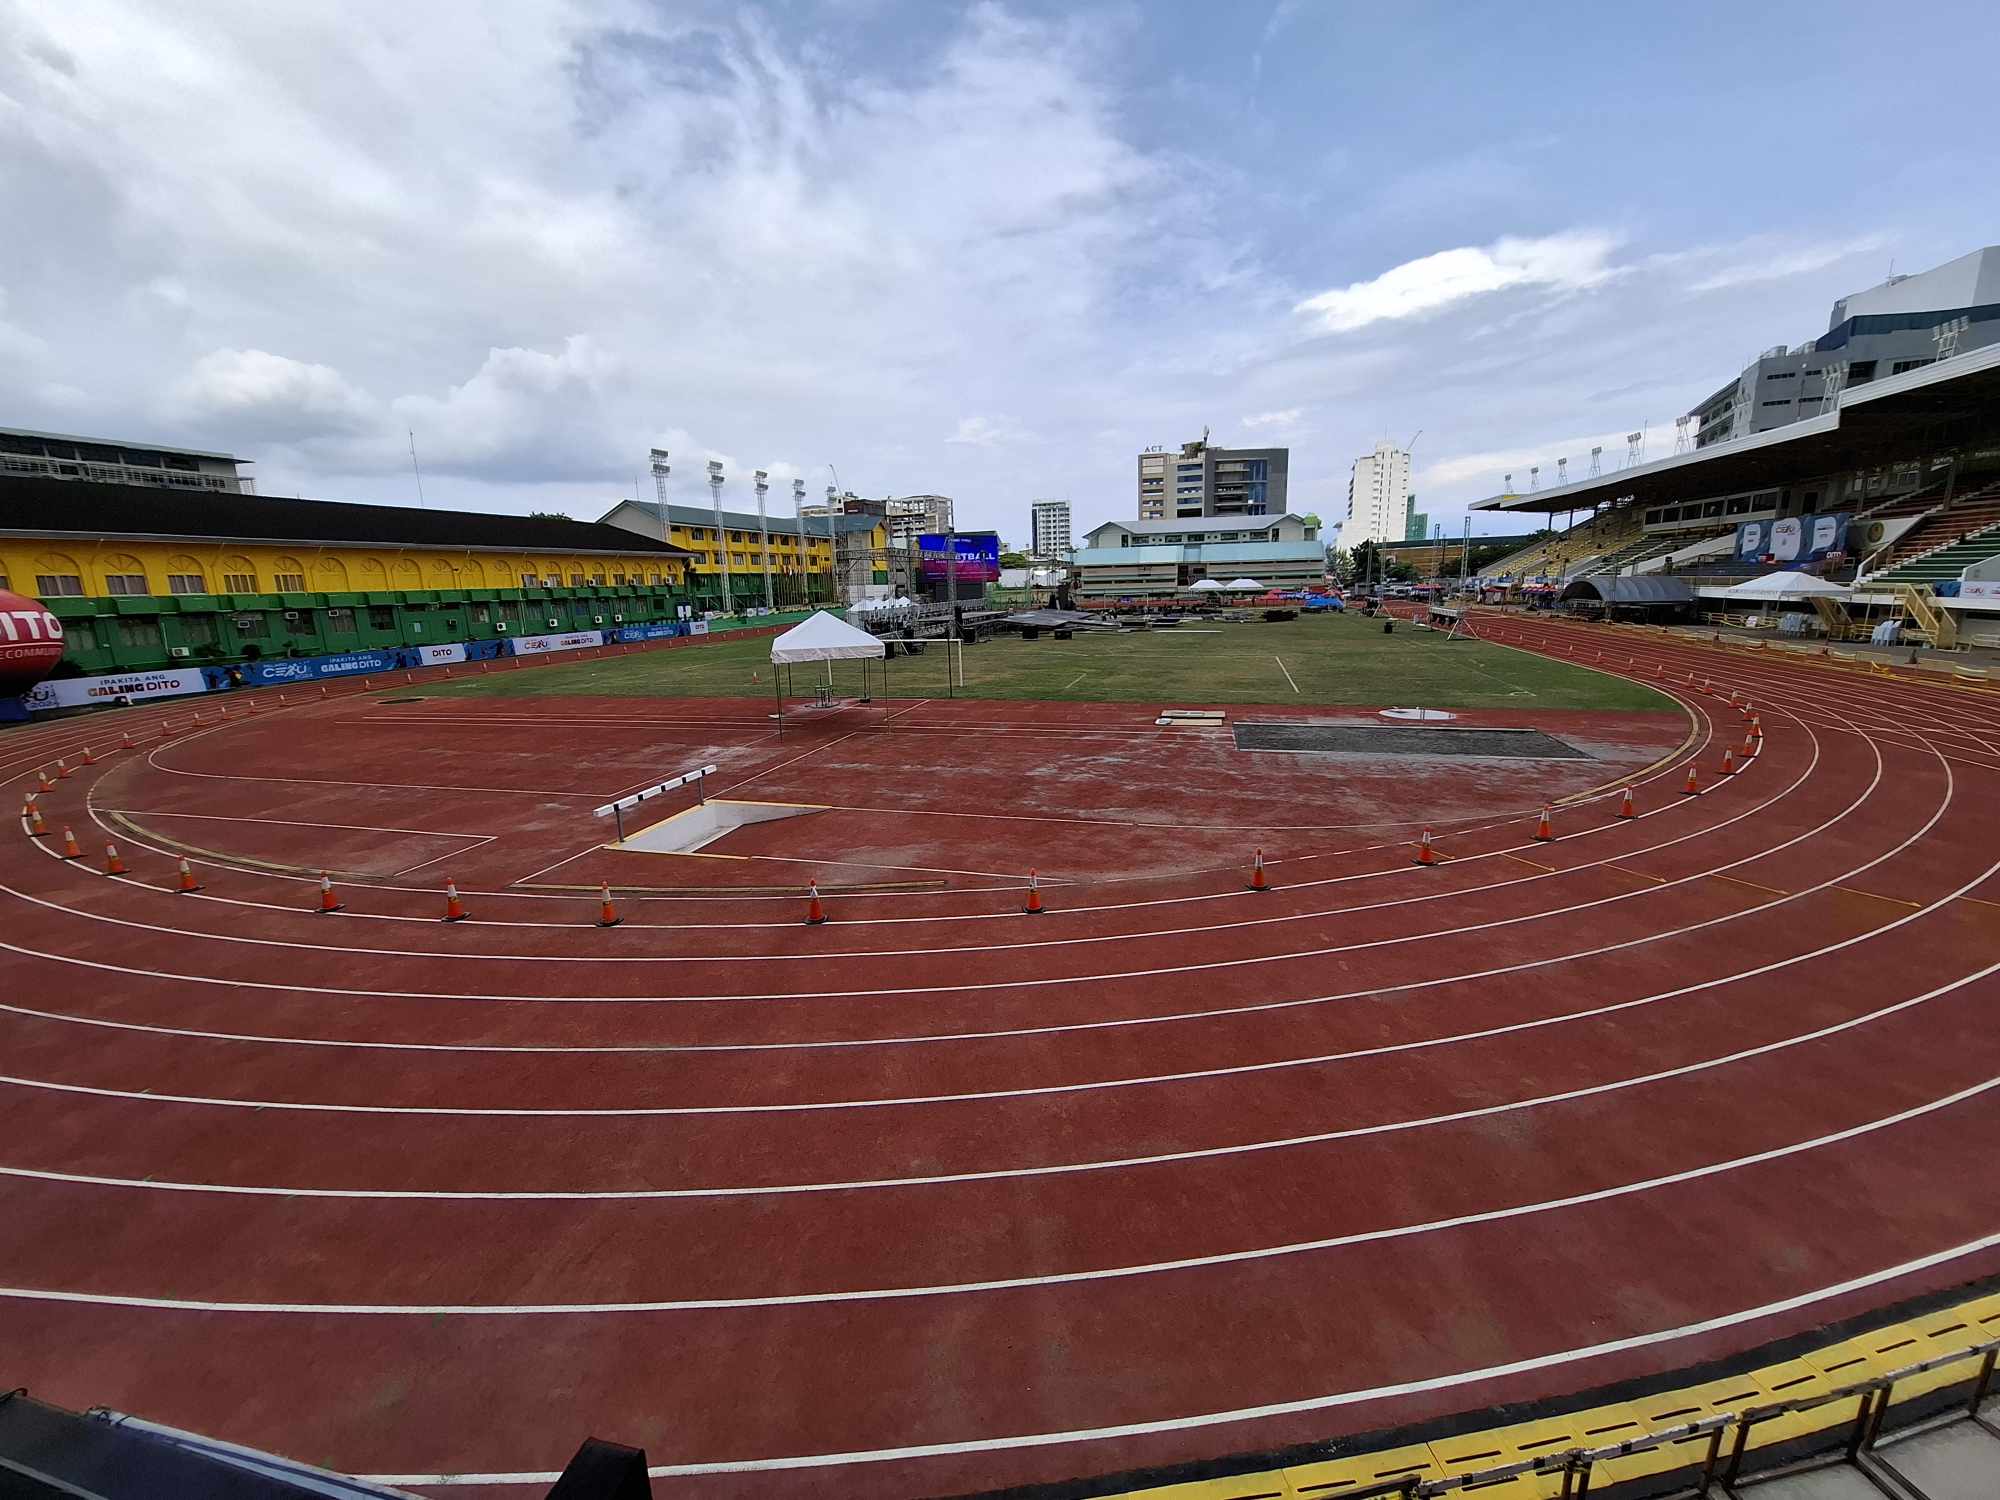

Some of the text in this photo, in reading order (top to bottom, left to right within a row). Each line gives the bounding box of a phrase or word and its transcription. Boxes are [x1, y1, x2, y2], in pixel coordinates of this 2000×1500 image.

[0, 611, 63, 641] ITO
[432, 648, 453, 658] DITO
[359, 659, 382, 668] DITO
[100, 673, 166, 686] IPAKITA ANG
[87, 679, 181, 697] GALING DITO
